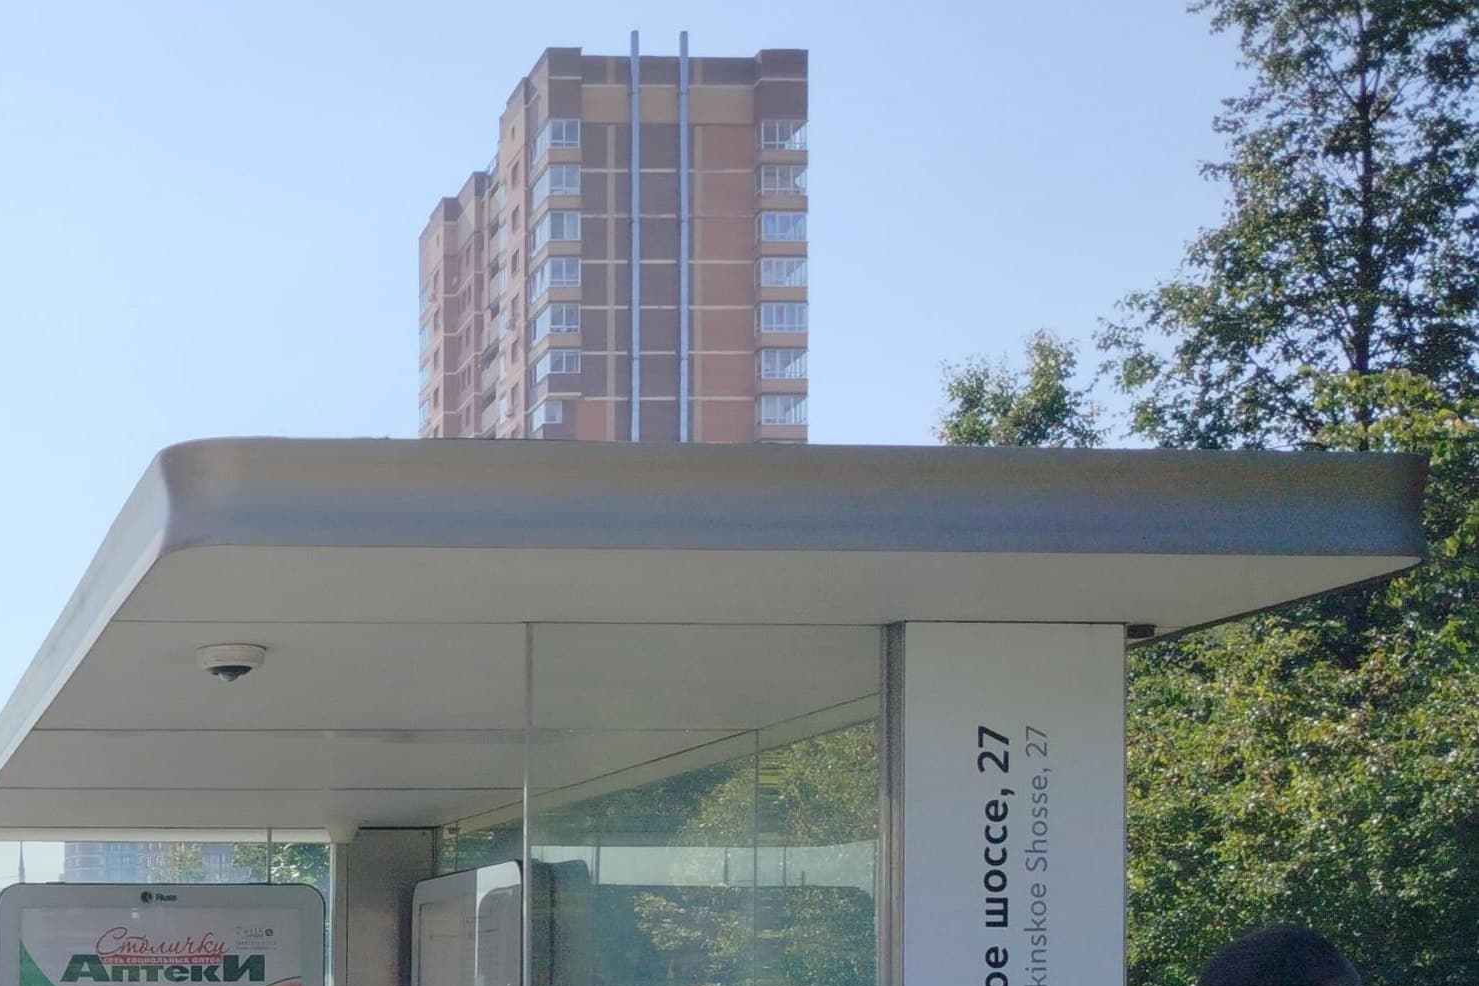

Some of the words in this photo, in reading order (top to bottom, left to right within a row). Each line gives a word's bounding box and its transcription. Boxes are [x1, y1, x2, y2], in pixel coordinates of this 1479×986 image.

[977, 725, 1010, 773] 27
[1025, 725, 1048, 757] 27
[1024, 767, 1052, 873] Shosse,
[983, 788, 1015, 928] шоссе,
[95, 926, 229, 956] Столички
